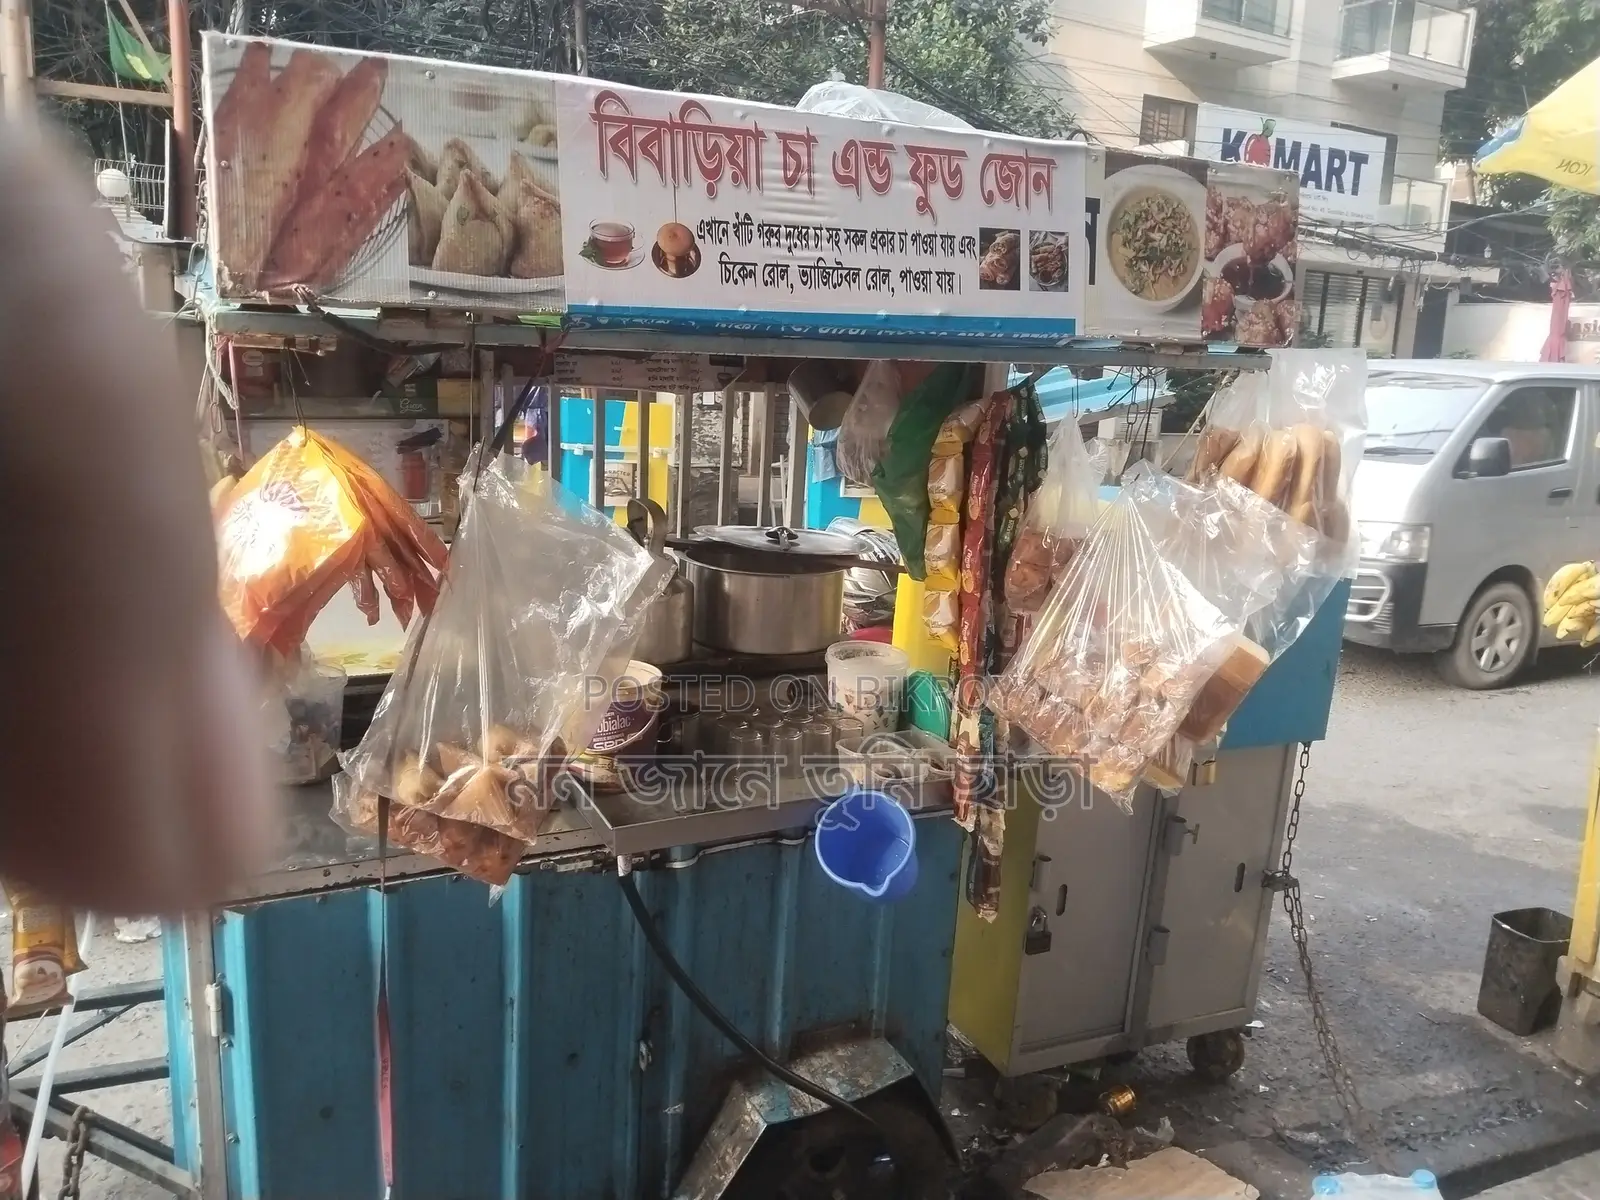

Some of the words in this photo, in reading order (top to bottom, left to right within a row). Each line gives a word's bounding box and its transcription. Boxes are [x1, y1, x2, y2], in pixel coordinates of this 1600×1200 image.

[588, 89, 768, 199] বিবাড়িয়া
[775, 124, 819, 198] চা
[831, 138, 897, 199] এন্ড
[903, 144, 970, 225] ফুড
[979, 149, 1058, 214] জোন
[697, 216, 730, 246] এখানে
[733, 212, 754, 248] খাঁটি
[757, 219, 782, 249] গরুর
[784, 224, 810, 256] দুধের
[812, 224, 823, 252] চা
[826, 227, 842, 255] সহ
[843, 227, 868, 254] সকল
[870, 228, 896, 256] প্রকার
[898, 229, 908, 256] চা
[911, 230, 938, 257] পাওয়া
[939, 231, 956, 257] যায়
[959, 235, 977, 260] এবং
[718, 251, 758, 287] চিকেন
[762, 260, 794, 294] রোল,
[797, 257, 862, 291] ভ্যাজিটেবল
[865, 265, 895, 297] রোল,
[899, 266, 933, 295] পাওয়া
